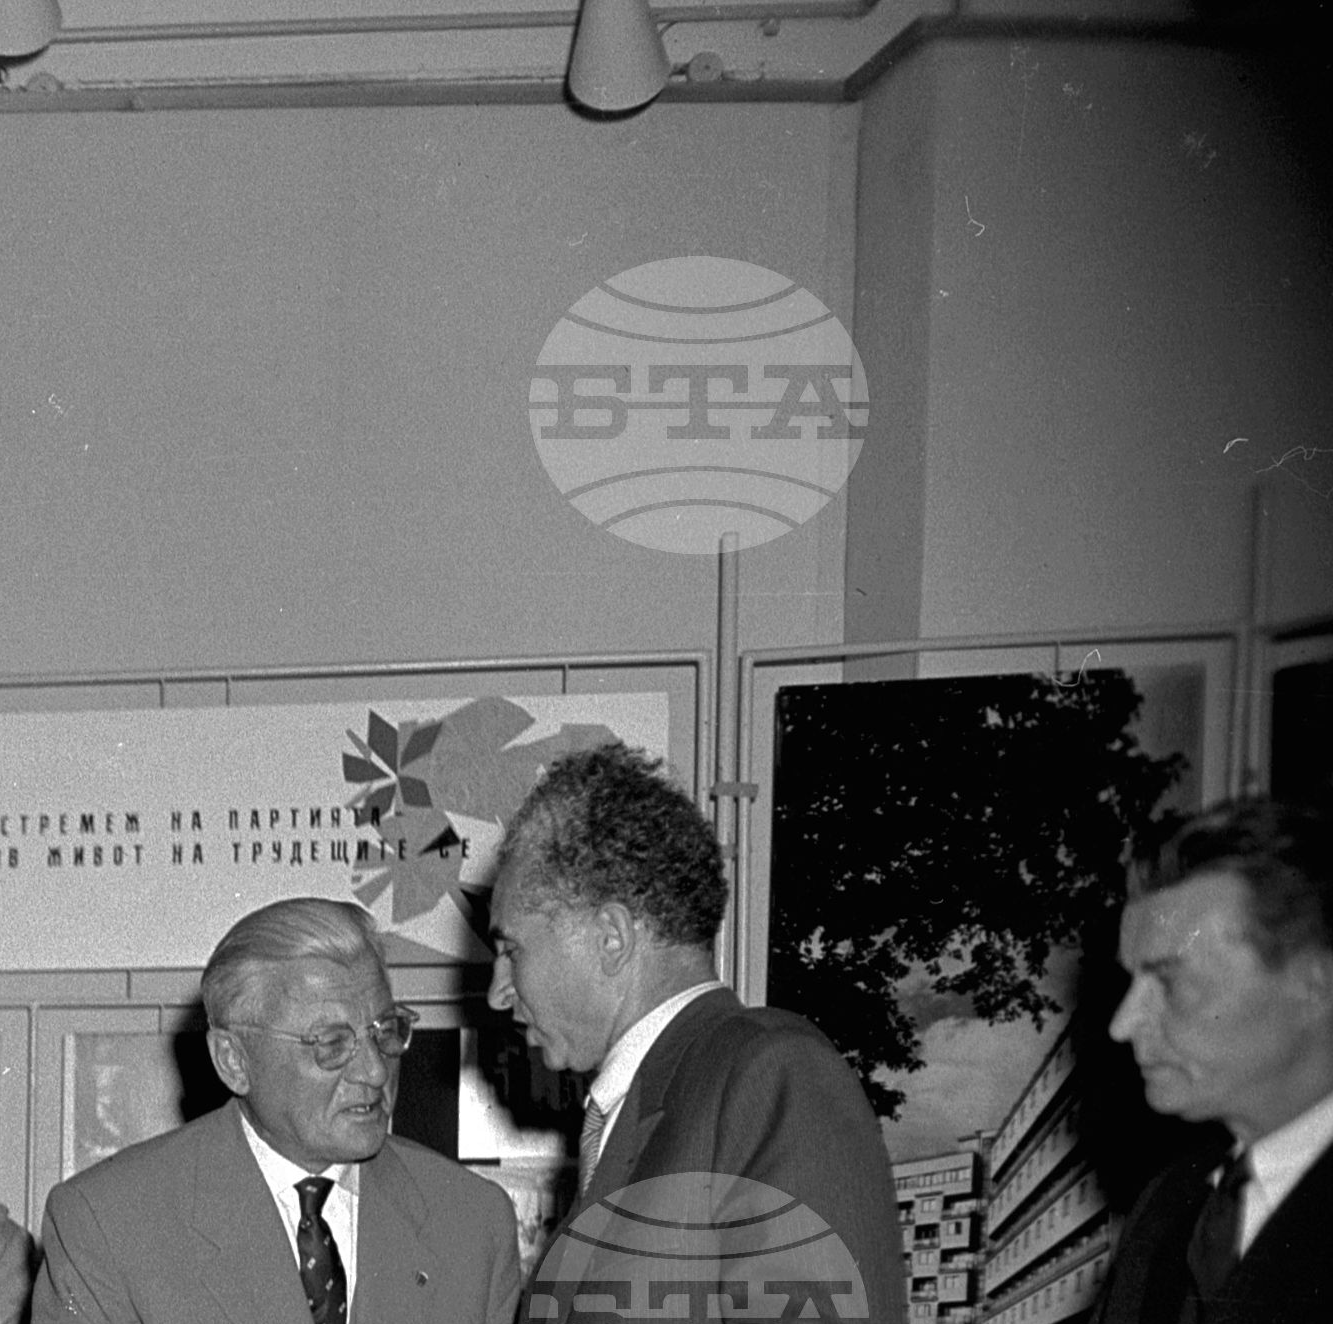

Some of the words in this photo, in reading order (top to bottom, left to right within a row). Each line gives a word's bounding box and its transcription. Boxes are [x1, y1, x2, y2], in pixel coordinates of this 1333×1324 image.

[0, 812, 140, 836] СТРЕМЕЖ
[171, 810, 202, 831] НА
[229, 806, 381, 831] ПАРТИЯТА
[47, 844, 143, 868] ЖИВОТ
[172, 842, 204, 865] НА
[232, 839, 407, 866] ТРУДЕЩИТЕ
